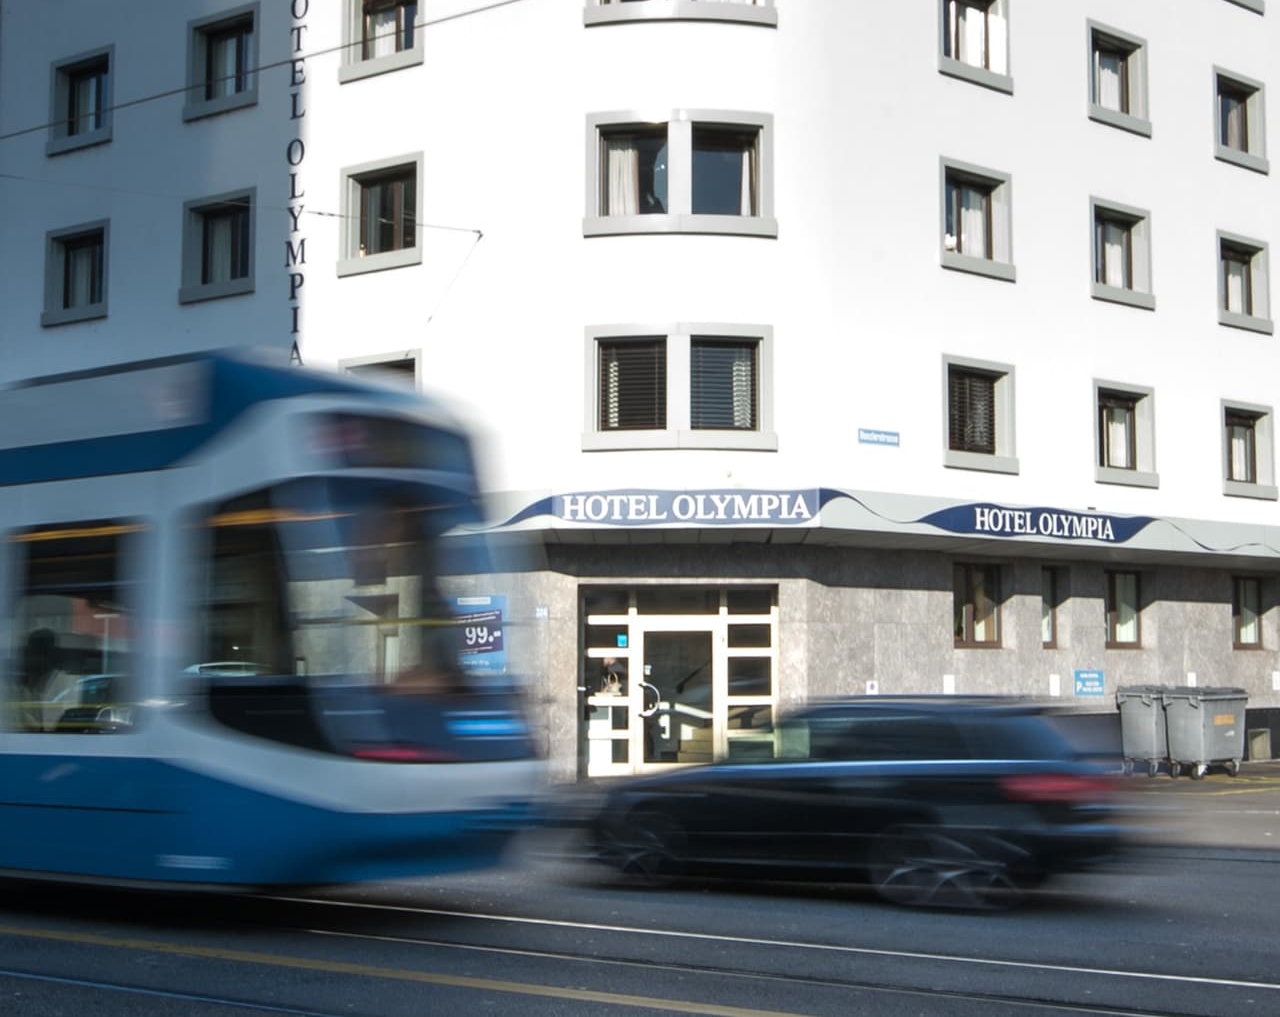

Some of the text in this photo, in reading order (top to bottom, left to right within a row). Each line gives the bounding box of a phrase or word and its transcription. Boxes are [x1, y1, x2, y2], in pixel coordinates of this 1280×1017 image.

[285, 138, 307, 366] OLYMPIA
[562, 494, 812, 520] HOTEL OLYMPIA
[975, 507, 1115, 540] HOTEL OLYMPIA
[464, 625, 502, 645] 99.-
